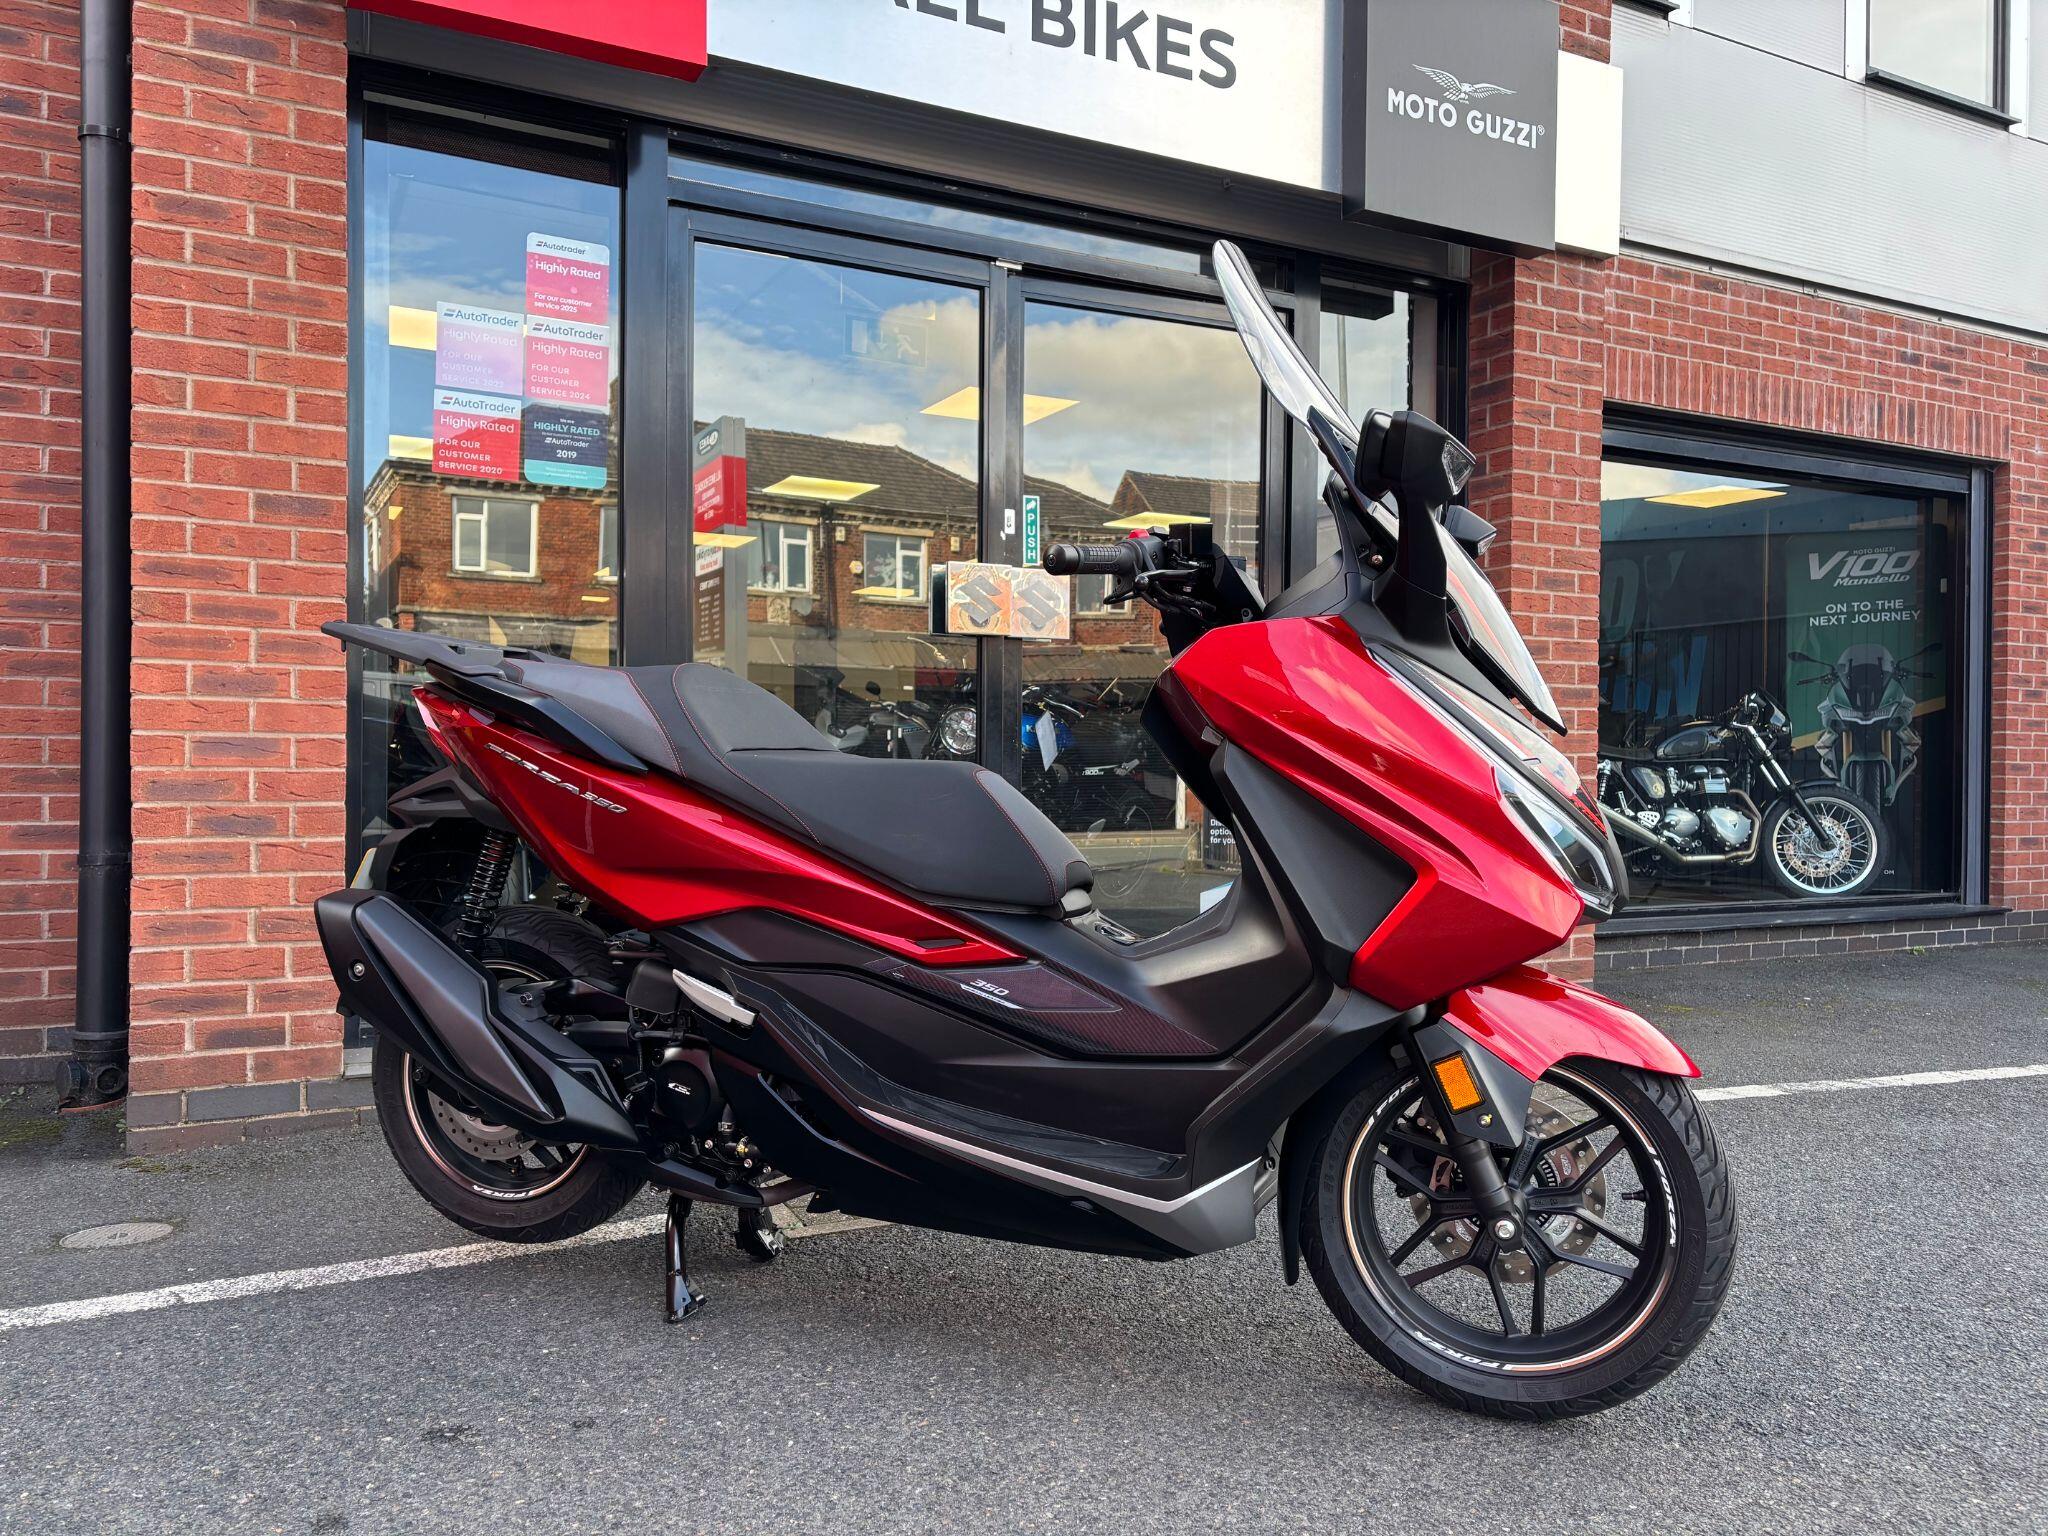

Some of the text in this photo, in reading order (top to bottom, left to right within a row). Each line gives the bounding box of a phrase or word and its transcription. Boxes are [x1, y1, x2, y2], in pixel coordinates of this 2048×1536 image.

[1031, 0, 1237, 89] BIKES
[1387, 87, 1458, 128] MOTO
[542, 241, 586, 255] Autotrader
[535, 260, 601, 280] Highly Rated
[534, 292, 546, 300] For
[559, 297, 593, 308] customer
[534, 301, 578, 313] service 2025
[454, 310, 519, 328] AutoTrader
[443, 327, 517, 346] Highly Rated
[543, 324, 603, 341] AutoTrader
[532, 341, 602, 360] Highly Rated
[531, 363, 570, 375] FOR OUR
[531, 374, 580, 388] CUSTOMER
[530, 385, 591, 400] SERVICE 2024
[452, 397, 516, 414] AutoTrader
[440, 414, 514, 433] Highly Rated
[534, 421, 568, 433] HIGHLY
[570, 425, 600, 436] RATED
[439, 437, 480, 449] FOR OUR
[551, 437, 590, 448] AutoTrader
[439, 449, 491, 462] CUSTOMER
[556, 450, 577, 459] 2019
[438, 460, 503, 475] SERVICE 2020
[1027, 513, 1036, 560] PUSH
[1809, 550, 1921, 580] V100
[1833, 573, 1910, 588] Mandello
[1826, 599, 1904, 614] ON TO THE
[1810, 610, 1921, 627] NEXT JOURNEY
[1210, 836, 1221, 844] for
[970, 978, 1010, 996] 350
[472, 1184, 527, 1198] FORZA
[1653, 1158, 1677, 1248] FORZA
[1415, 1330, 1500, 1369] FORZA
